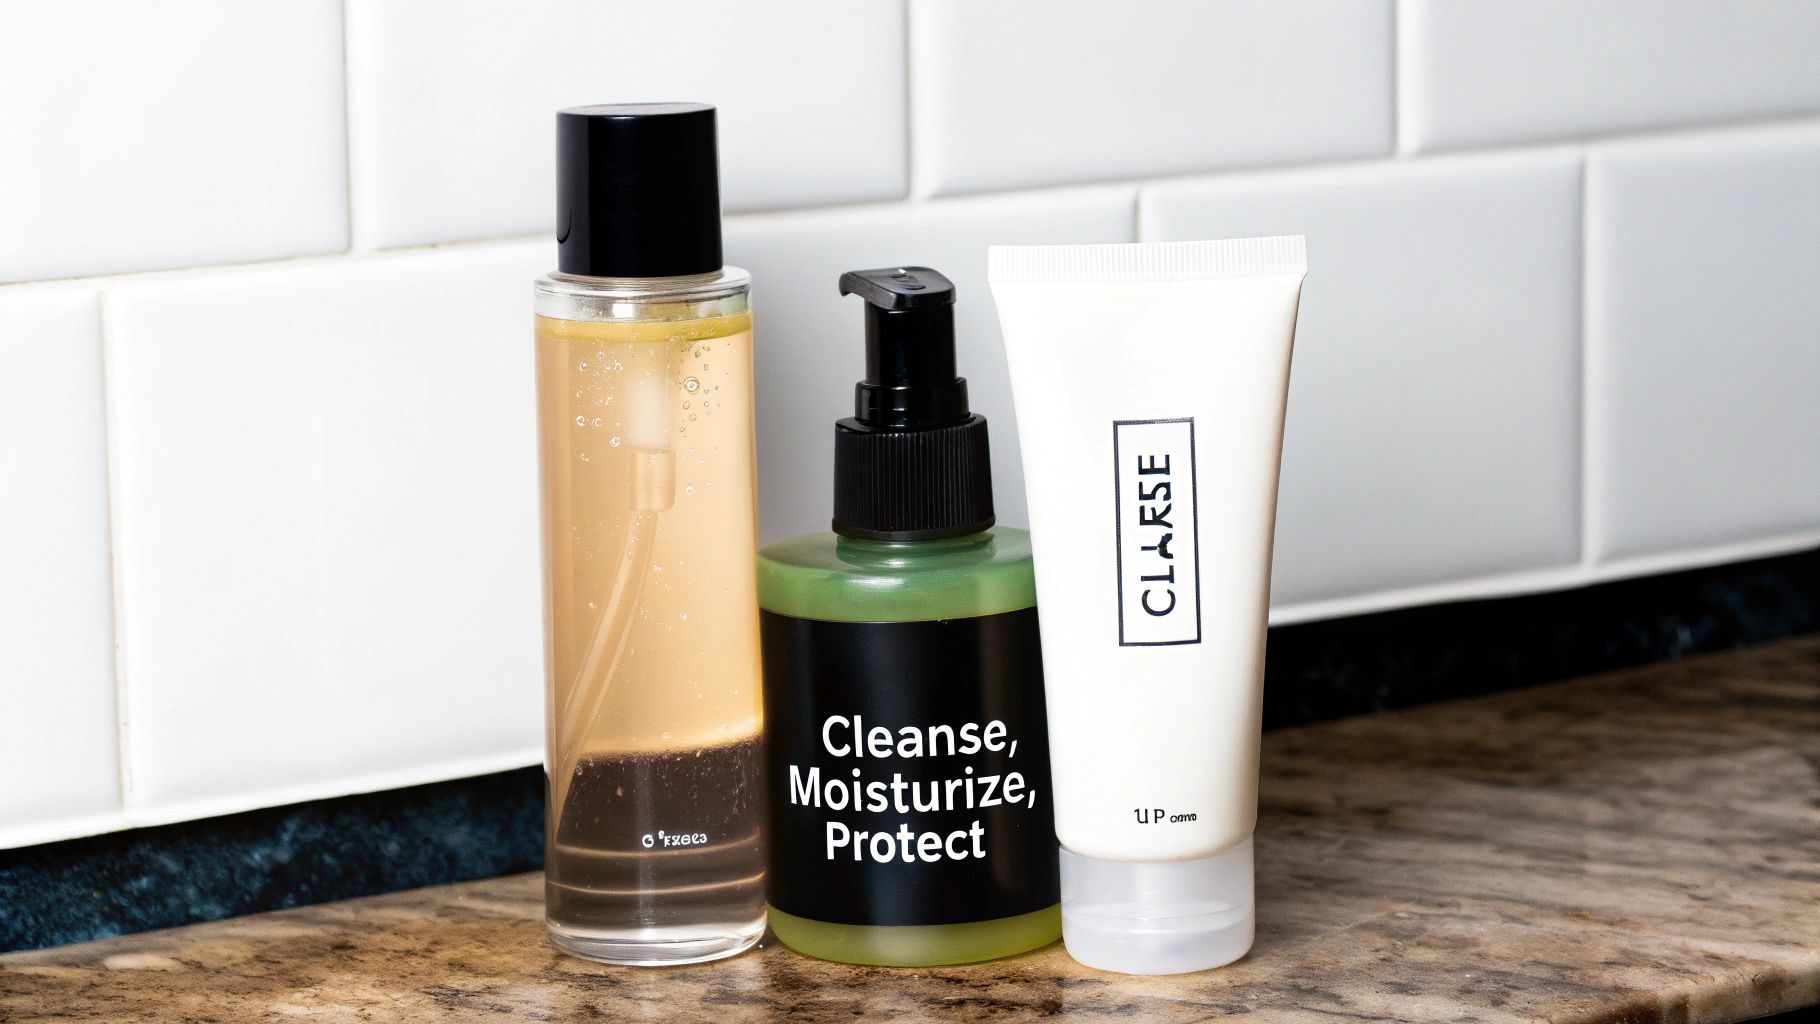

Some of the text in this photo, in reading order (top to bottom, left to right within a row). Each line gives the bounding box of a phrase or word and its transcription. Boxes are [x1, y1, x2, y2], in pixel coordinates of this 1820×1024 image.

[822, 714, 1018, 759] Cleanse,
[789, 764, 1036, 814] Moisturize,
[825, 820, 987, 864] Protect
